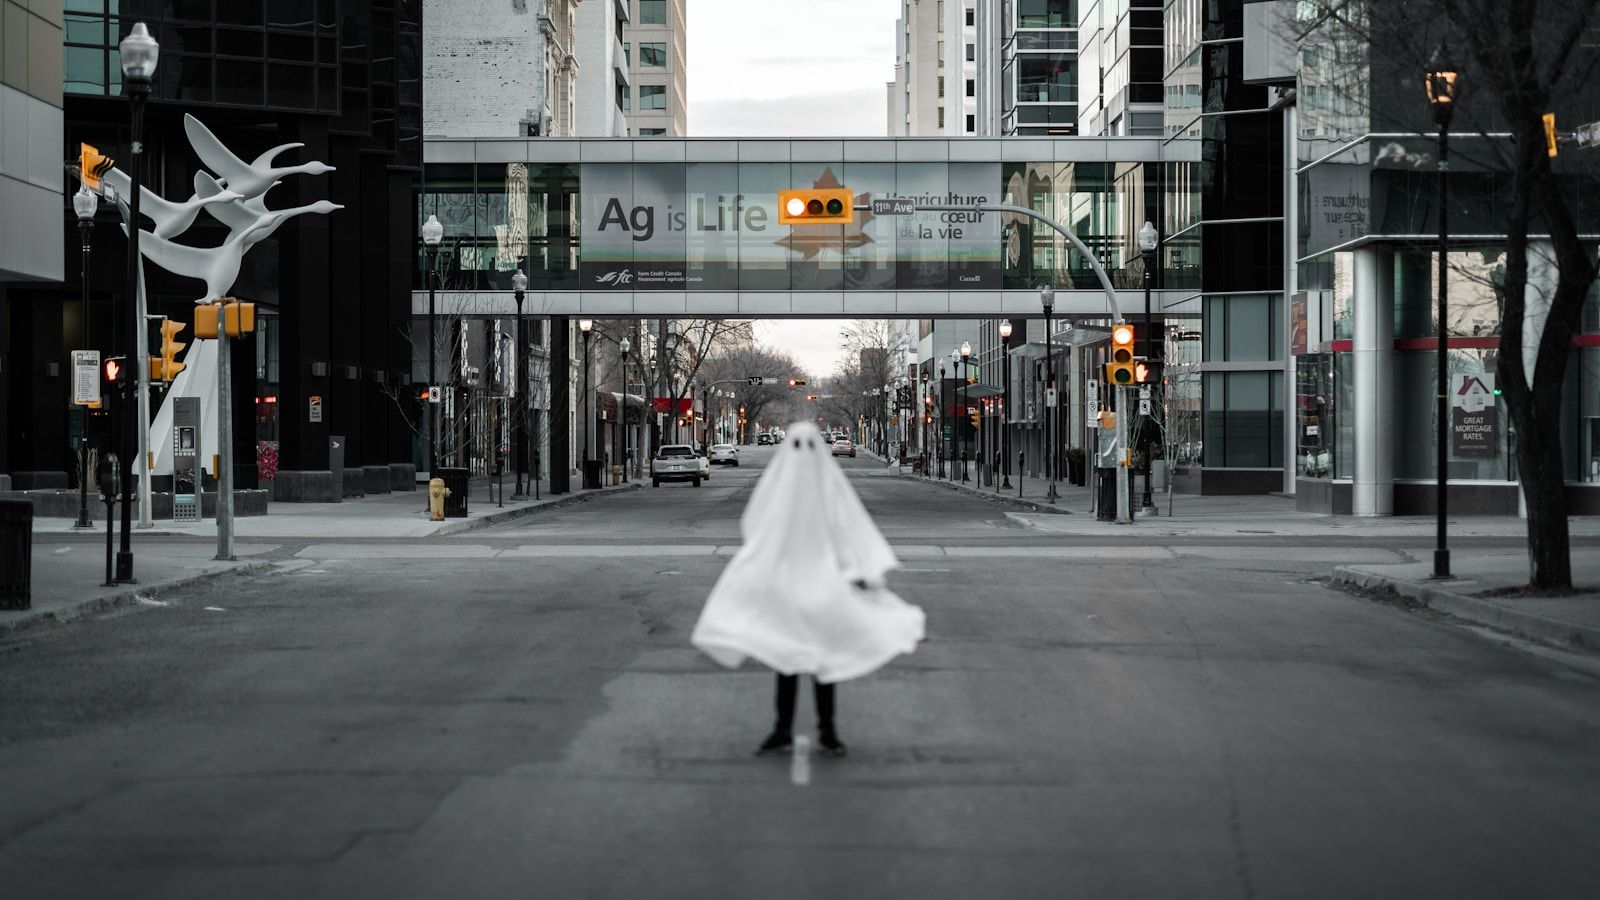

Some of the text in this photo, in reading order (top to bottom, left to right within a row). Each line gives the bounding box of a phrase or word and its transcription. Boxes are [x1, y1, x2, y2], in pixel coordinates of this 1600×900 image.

[875, 202, 912, 212] 11th Ave
[597, 195, 767, 241] Ag is Life
[940, 211, 985, 223] cœur
[900, 224, 963, 239] de la vie
